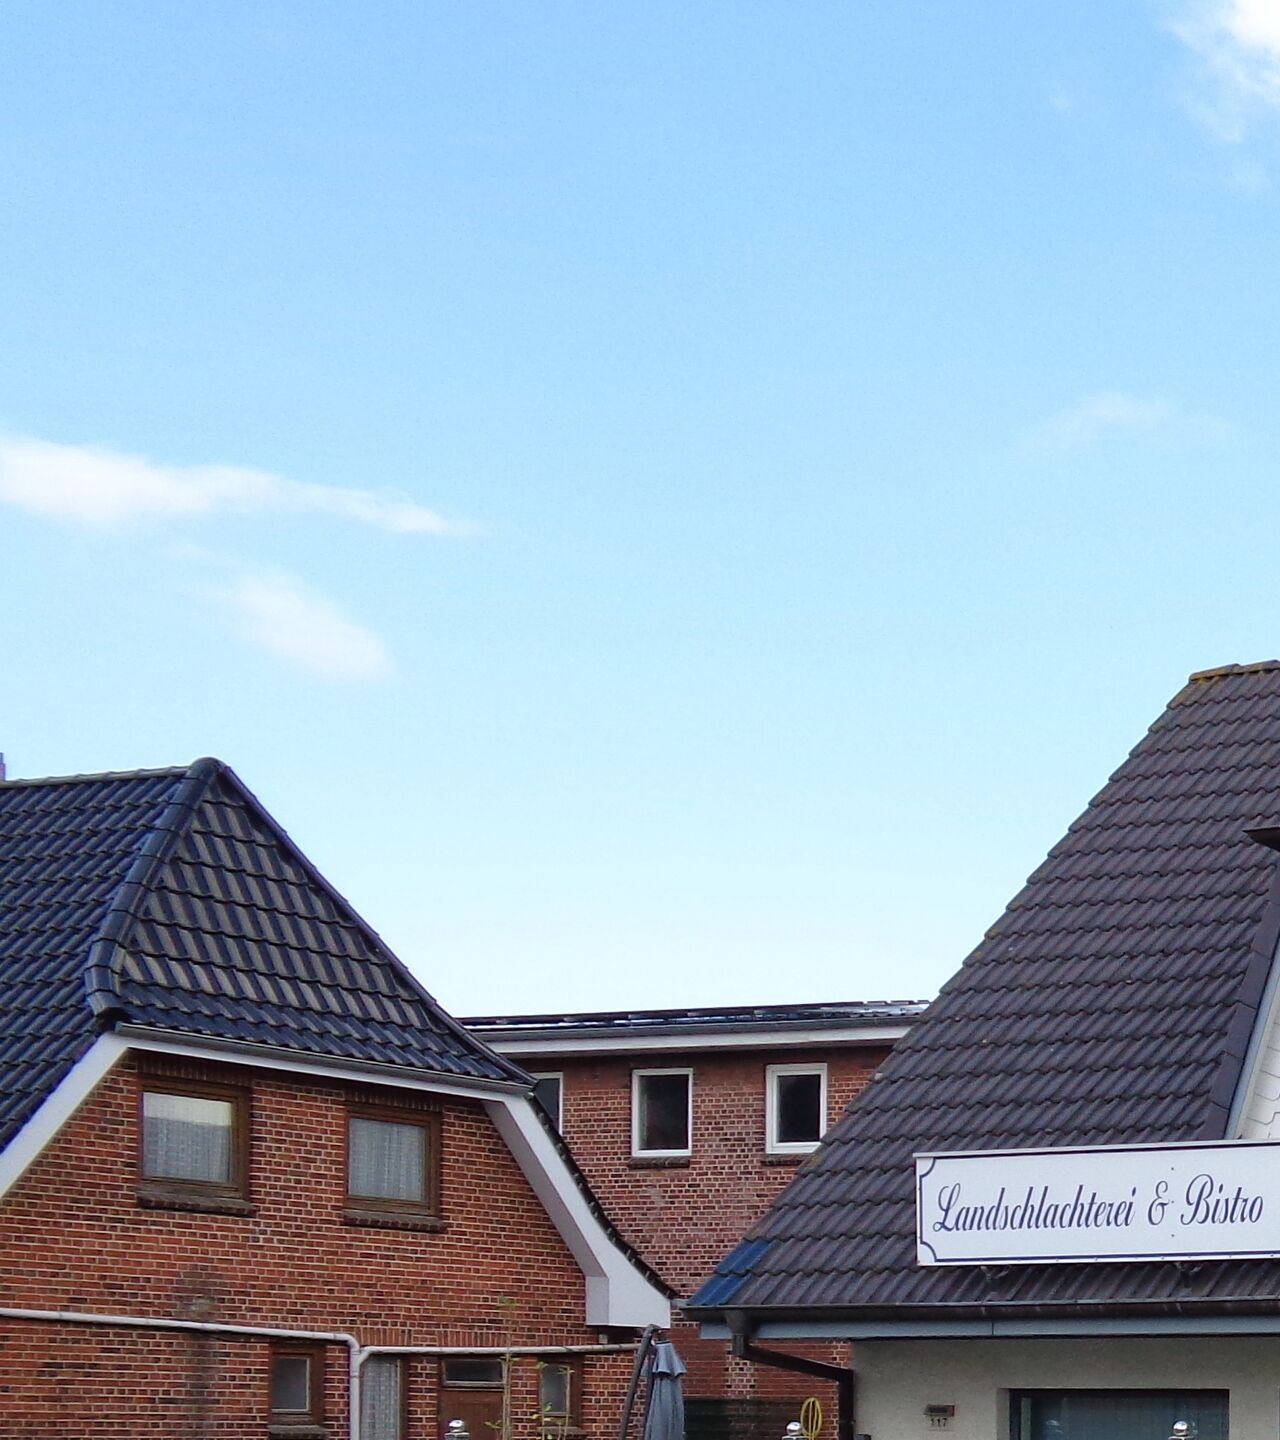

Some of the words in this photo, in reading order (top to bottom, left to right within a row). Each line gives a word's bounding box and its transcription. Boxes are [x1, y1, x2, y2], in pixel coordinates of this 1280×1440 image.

[933, 1183, 1137, 1232] Landschlachterei
[1148, 1180, 1170, 1226] &
[1180, 1173, 1265, 1225] Bistro
